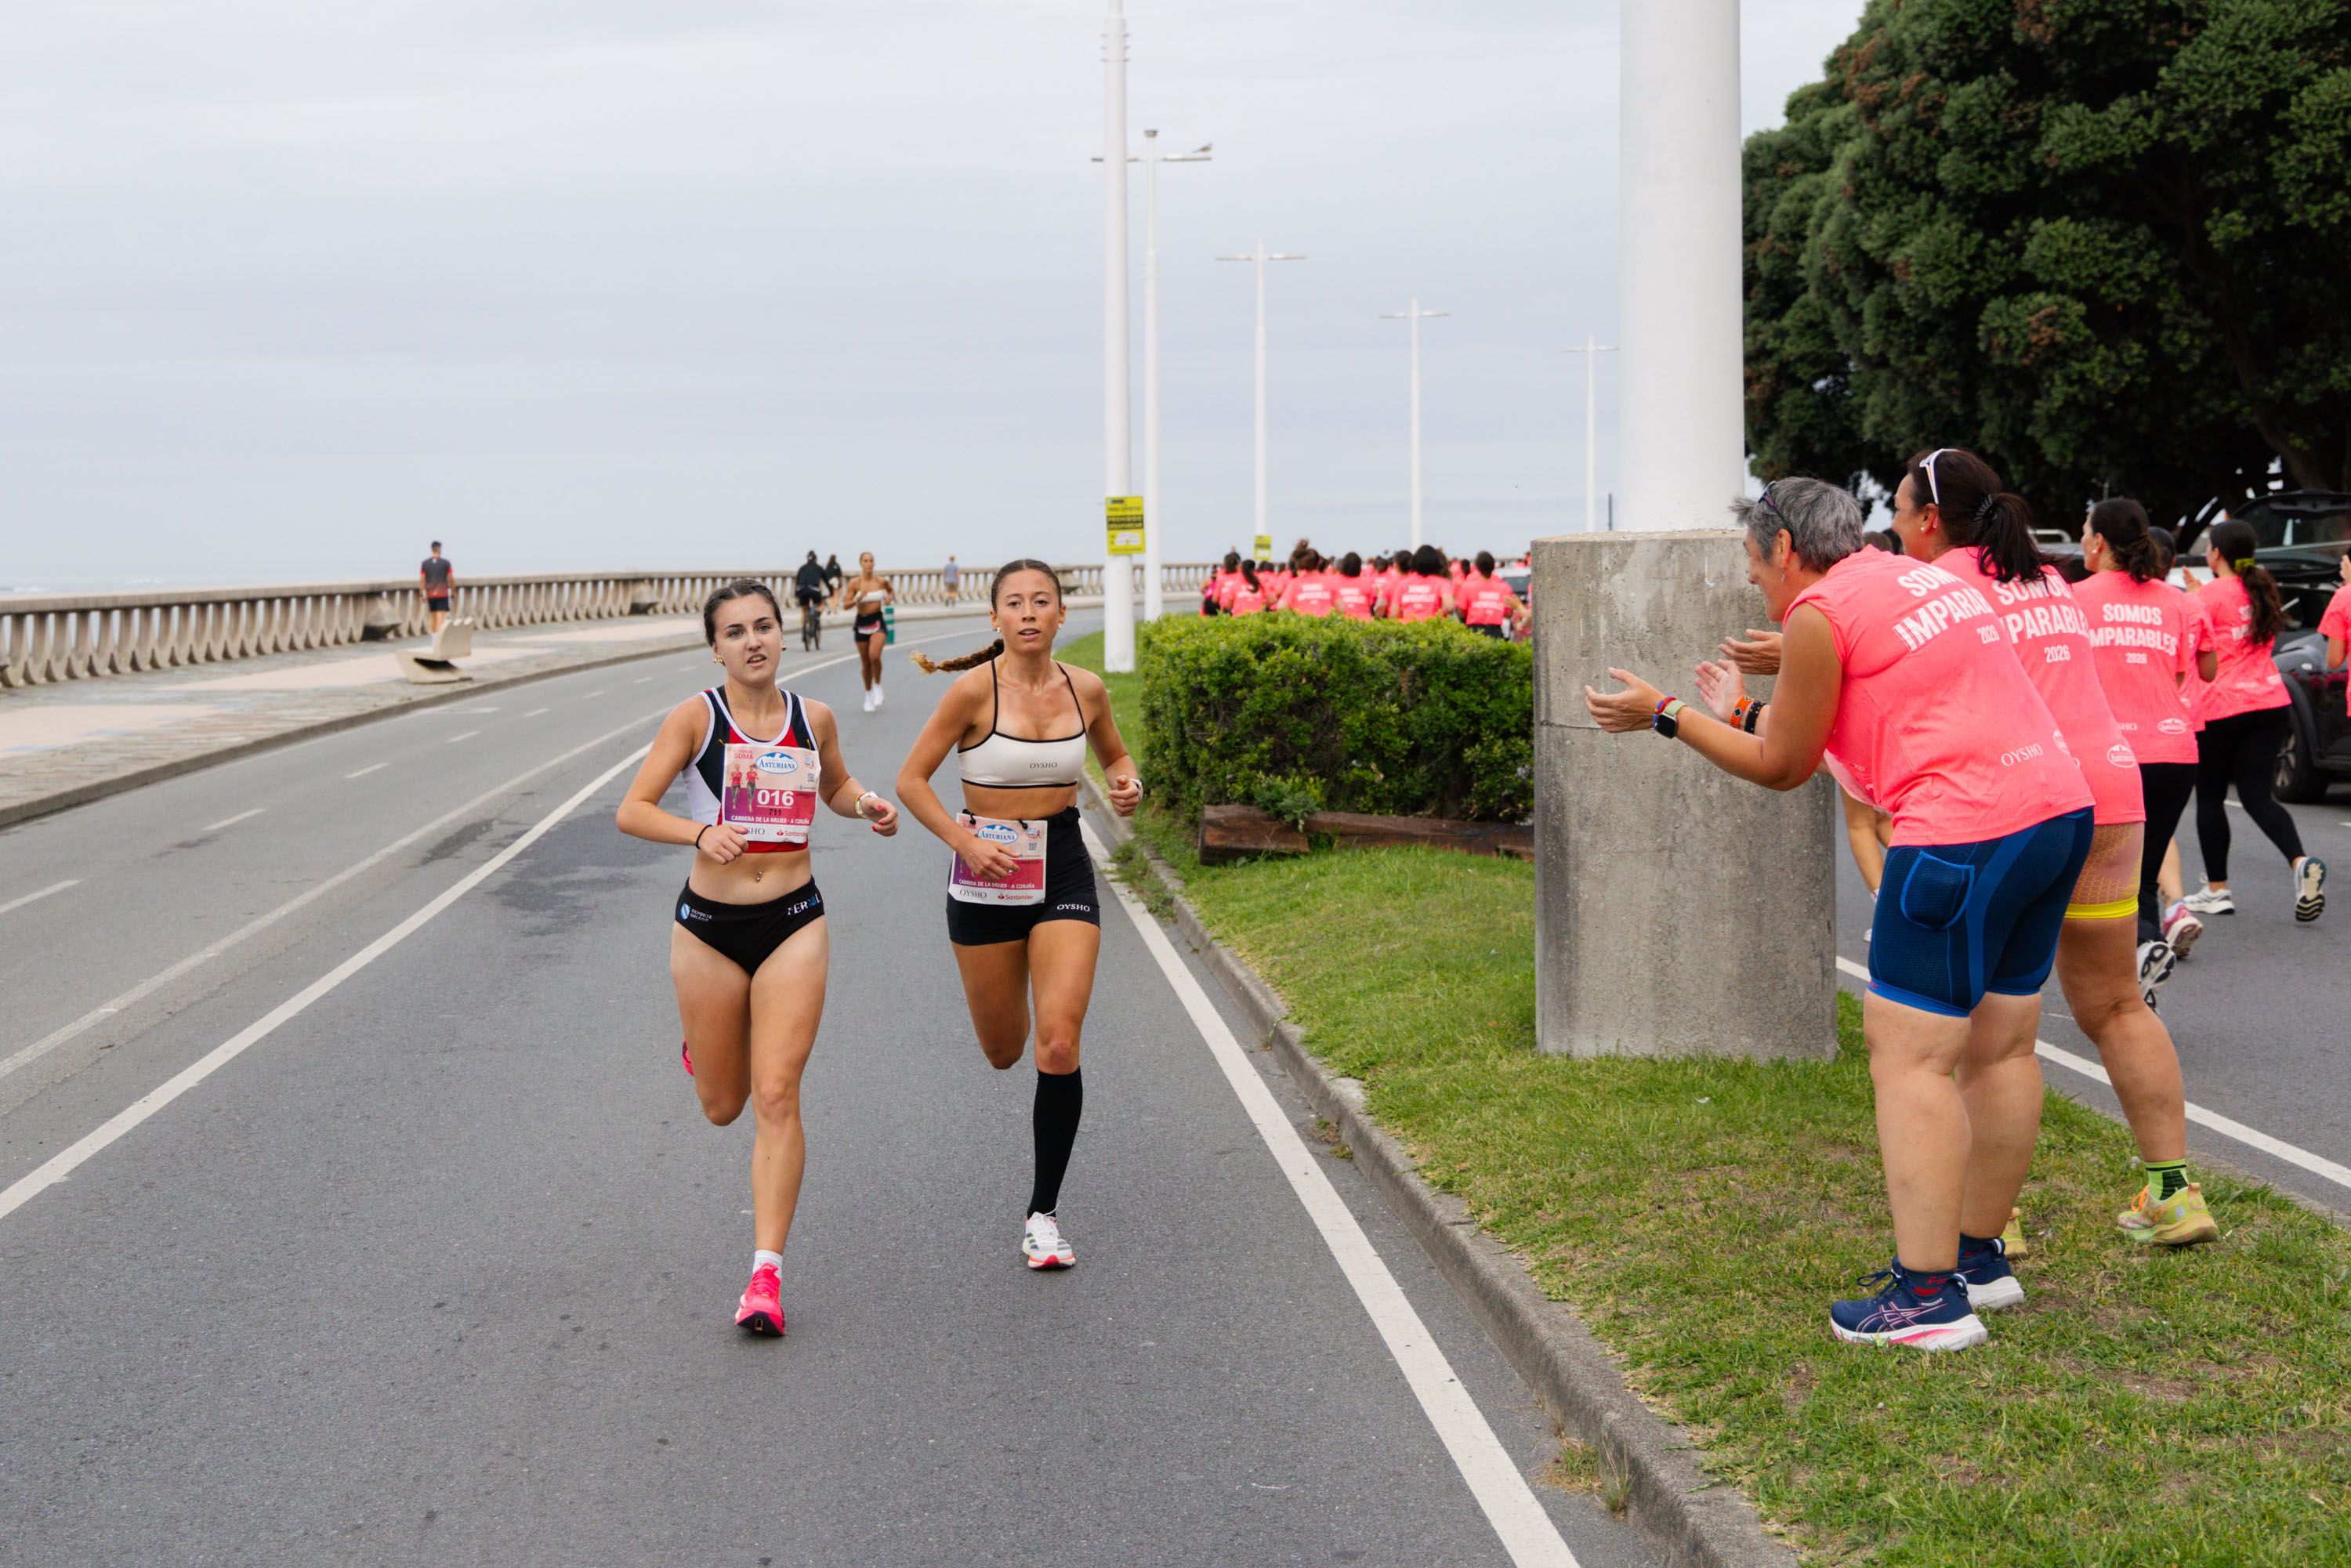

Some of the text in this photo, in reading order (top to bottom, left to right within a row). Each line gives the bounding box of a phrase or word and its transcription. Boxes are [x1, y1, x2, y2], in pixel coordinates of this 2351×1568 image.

[1896, 564, 1968, 597] SOM
[2102, 603, 2163, 626] SOMOS
[1976, 625, 2000, 644] 2026
[2088, 626, 2178, 657] MPARABLES
[2044, 644, 2070, 664] 2026
[2000, 742, 2044, 767] OYSHO
[759, 759, 795, 770] ASTURIANA
[757, 789, 795, 806] 016
[980, 830, 1016, 841] ASTURIANA
[959, 889, 987, 899] OYSHO
[1056, 904, 1090, 912] OYSHO
